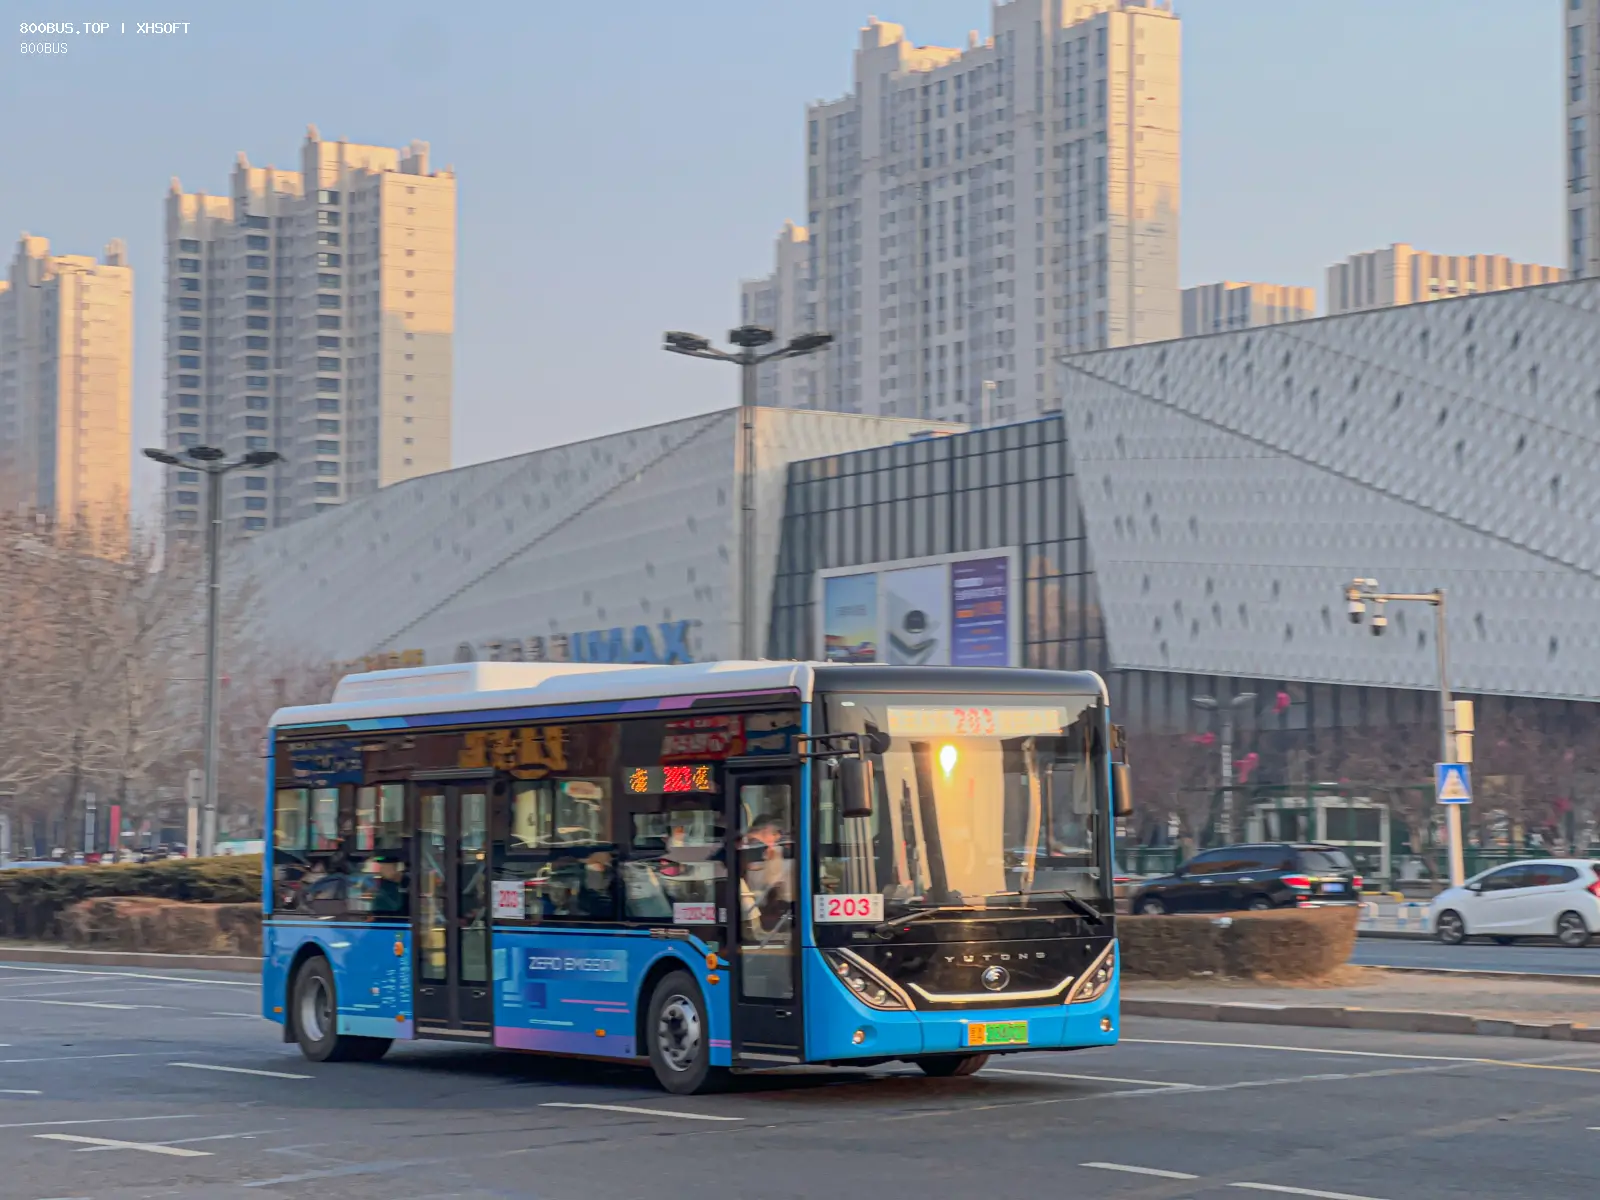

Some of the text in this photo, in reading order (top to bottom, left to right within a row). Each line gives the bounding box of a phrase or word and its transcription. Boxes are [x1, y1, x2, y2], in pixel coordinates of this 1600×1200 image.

[573, 619, 695, 665] IMAX
[828, 898, 870, 916] 203
[528, 956, 562, 971] ZERO
[944, 952, 1046, 963] YUTONG
